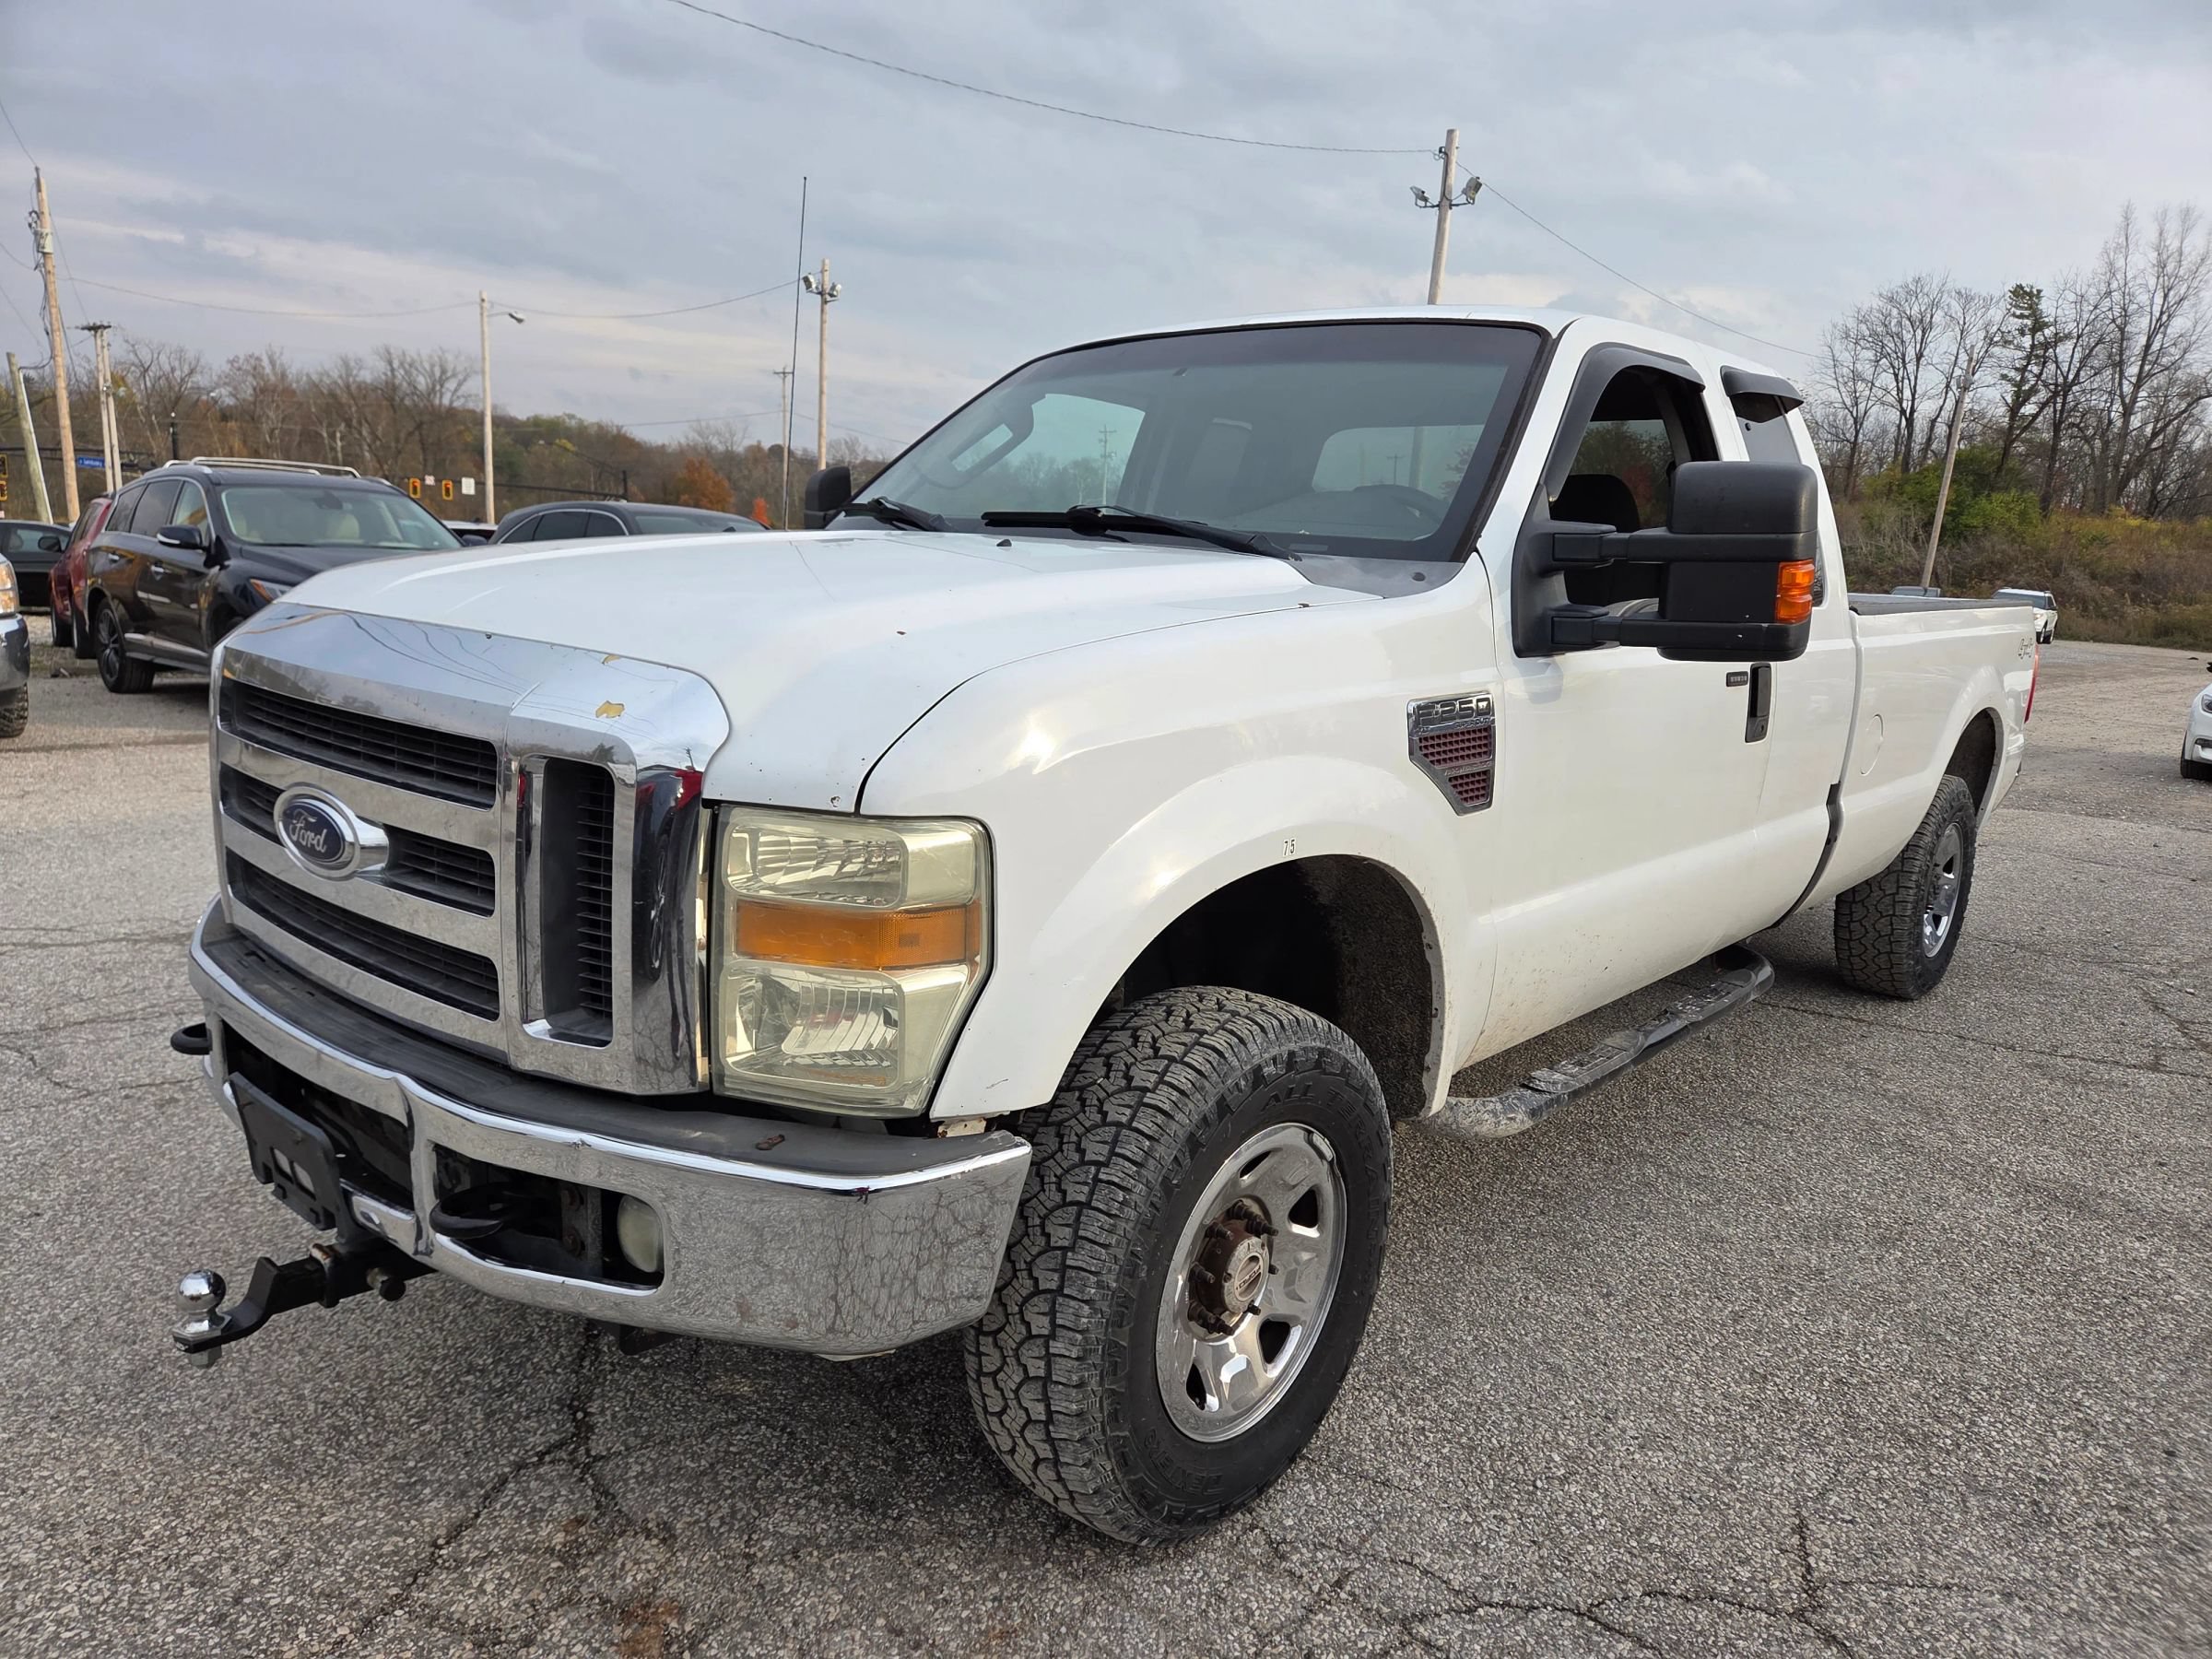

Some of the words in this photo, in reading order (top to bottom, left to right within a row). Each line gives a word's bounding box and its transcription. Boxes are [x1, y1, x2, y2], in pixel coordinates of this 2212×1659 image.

[288, 808, 329, 853] Ford
[1284, 839, 1296, 856] 75
[1261, 1080, 1315, 1112] ALL
[1327, 1086, 1381, 1240] TERRAIN
